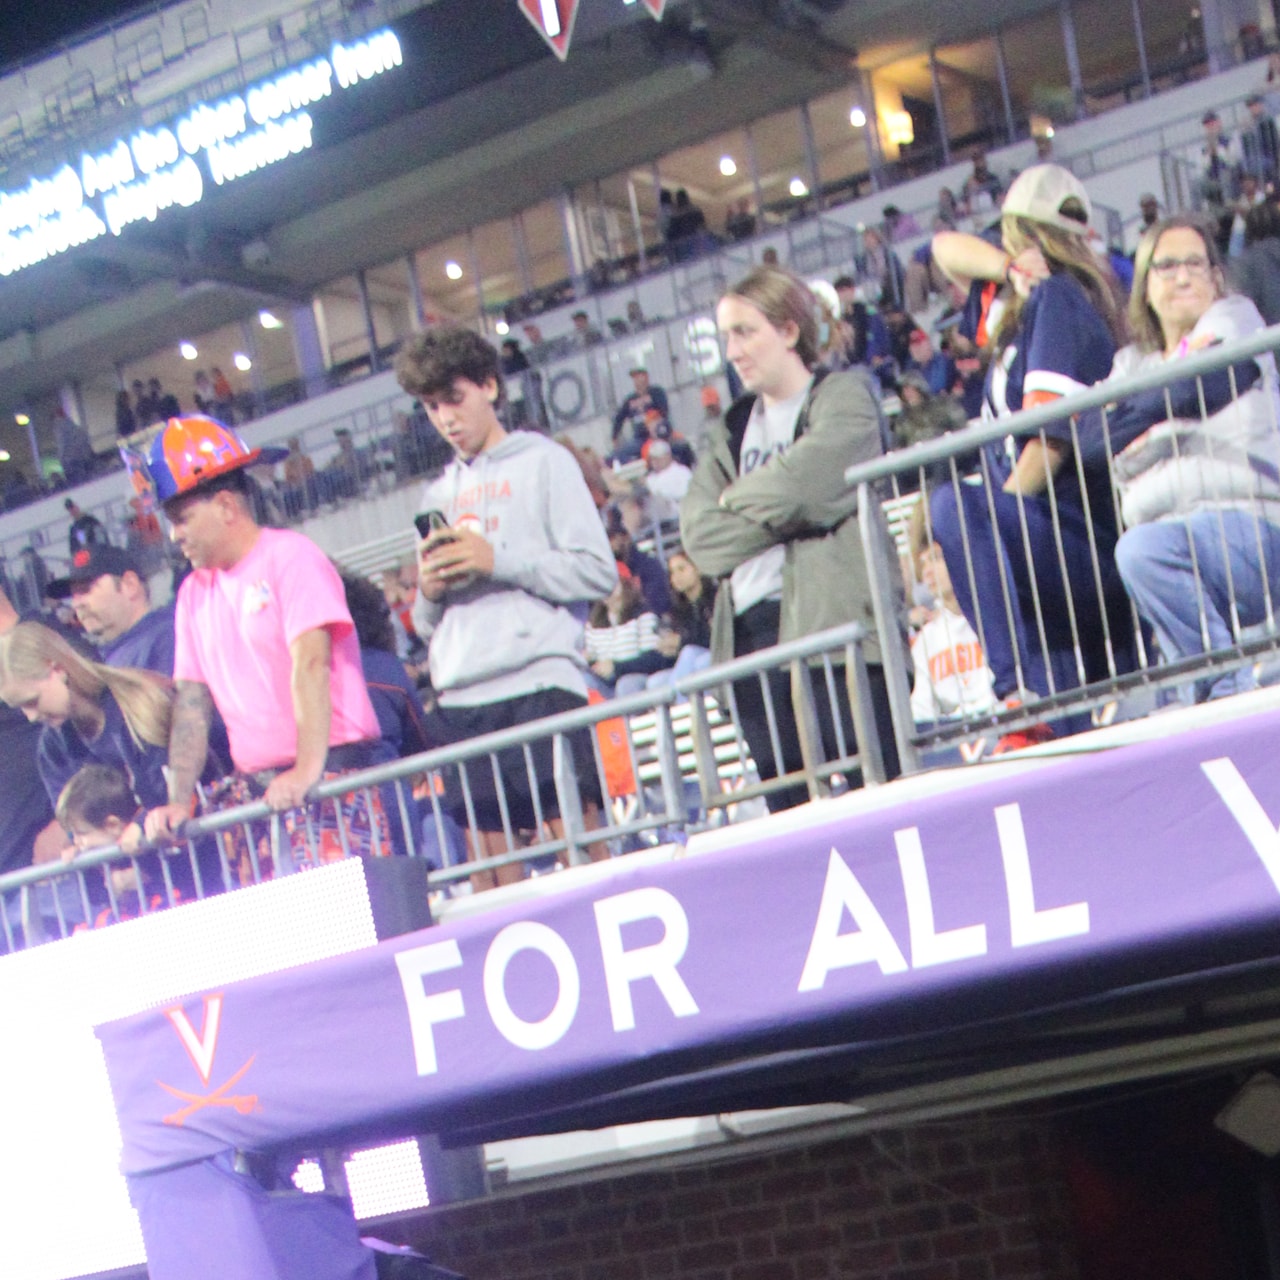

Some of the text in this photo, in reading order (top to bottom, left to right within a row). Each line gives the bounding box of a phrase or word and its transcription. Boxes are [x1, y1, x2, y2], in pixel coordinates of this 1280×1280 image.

[394, 888, 699, 1077] FOR
[797, 803, 1091, 993] ALL
[163, 993, 225, 1087] V
